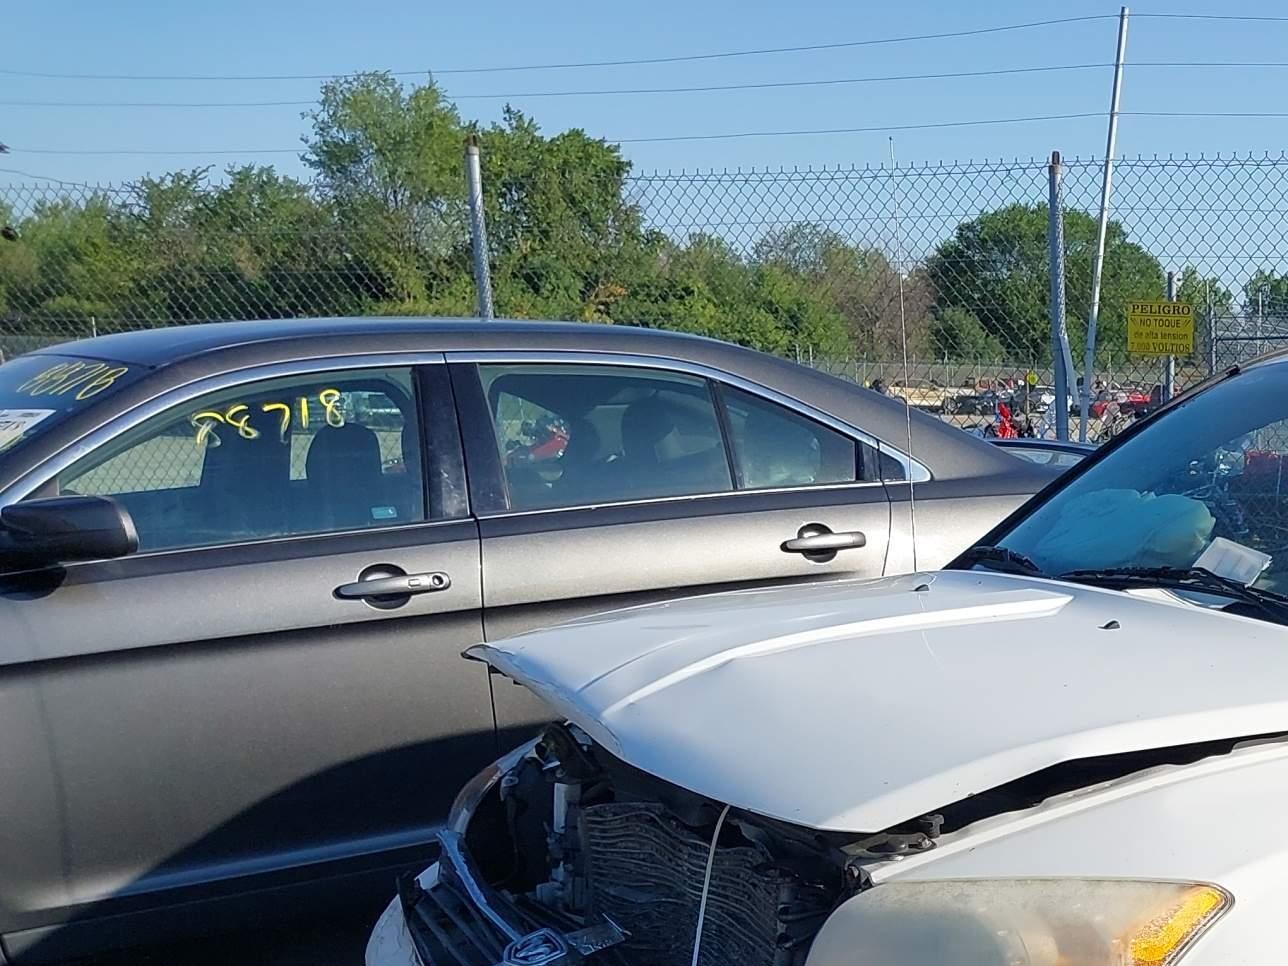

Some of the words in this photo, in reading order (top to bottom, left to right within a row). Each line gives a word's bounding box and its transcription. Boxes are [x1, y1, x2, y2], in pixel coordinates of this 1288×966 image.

[1131, 304, 1190, 316] PELIGRO
[1139, 318, 1152, 328] NO
[1153, 318, 1181, 328] TOQUE
[1152, 342, 1190, 353] VOLTIOS
